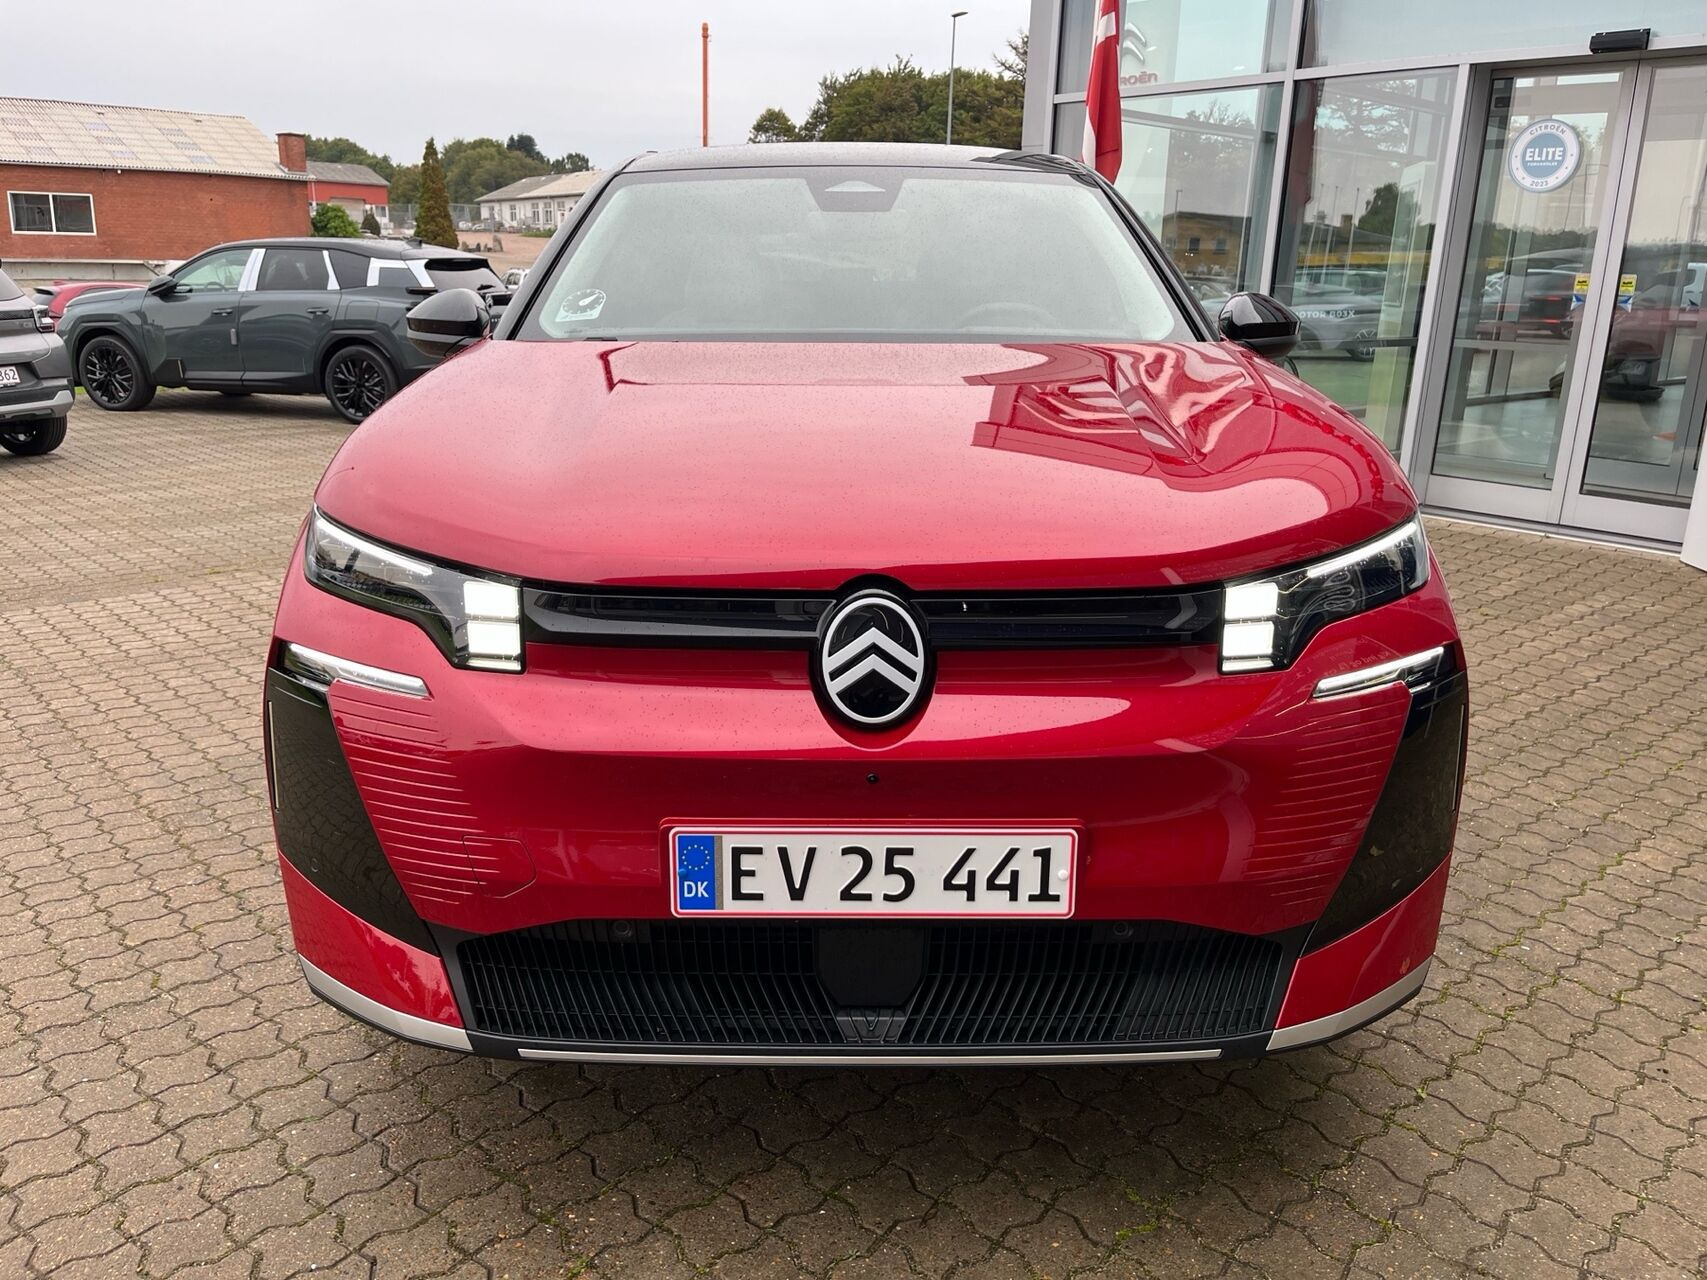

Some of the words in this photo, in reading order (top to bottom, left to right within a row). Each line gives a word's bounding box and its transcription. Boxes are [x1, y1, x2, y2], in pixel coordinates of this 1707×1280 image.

[1525, 147, 1564, 161] ELITE
[730, 846, 817, 901] EV
[838, 846, 915, 902] 25
[943, 847, 1061, 902] 441
[683, 880, 709, 898] DK
